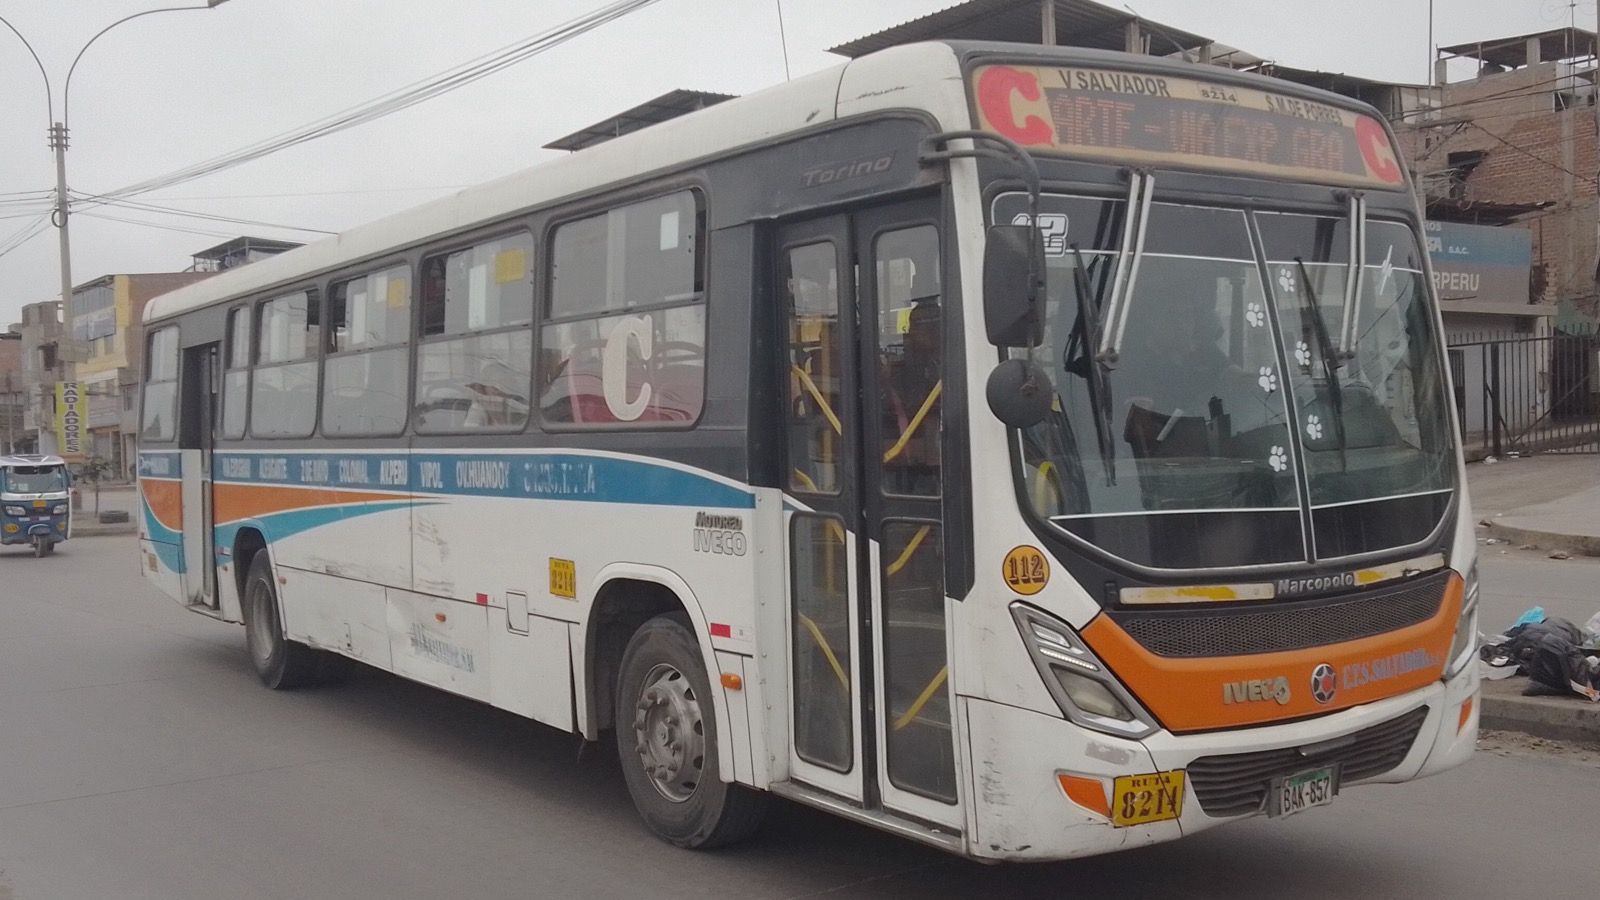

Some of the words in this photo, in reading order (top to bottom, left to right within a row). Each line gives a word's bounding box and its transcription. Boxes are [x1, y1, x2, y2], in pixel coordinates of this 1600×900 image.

[1058, 70, 1072, 89] V
[1076, 71, 1171, 98] SALVADOR
[1201, 89, 1238, 102] 8214
[978, 65, 1055, 148] C
[1355, 115, 1400, 182] C
[803, 155, 892, 186] Torino
[602, 314, 653, 421] C
[63, 382, 81, 453] RADIADORES
[693, 528, 747, 557] IVECO
[1008, 554, 1045, 585] 112
[1121, 785, 1178, 819] 8214
[1283, 775, 1330, 813] BAK-857
